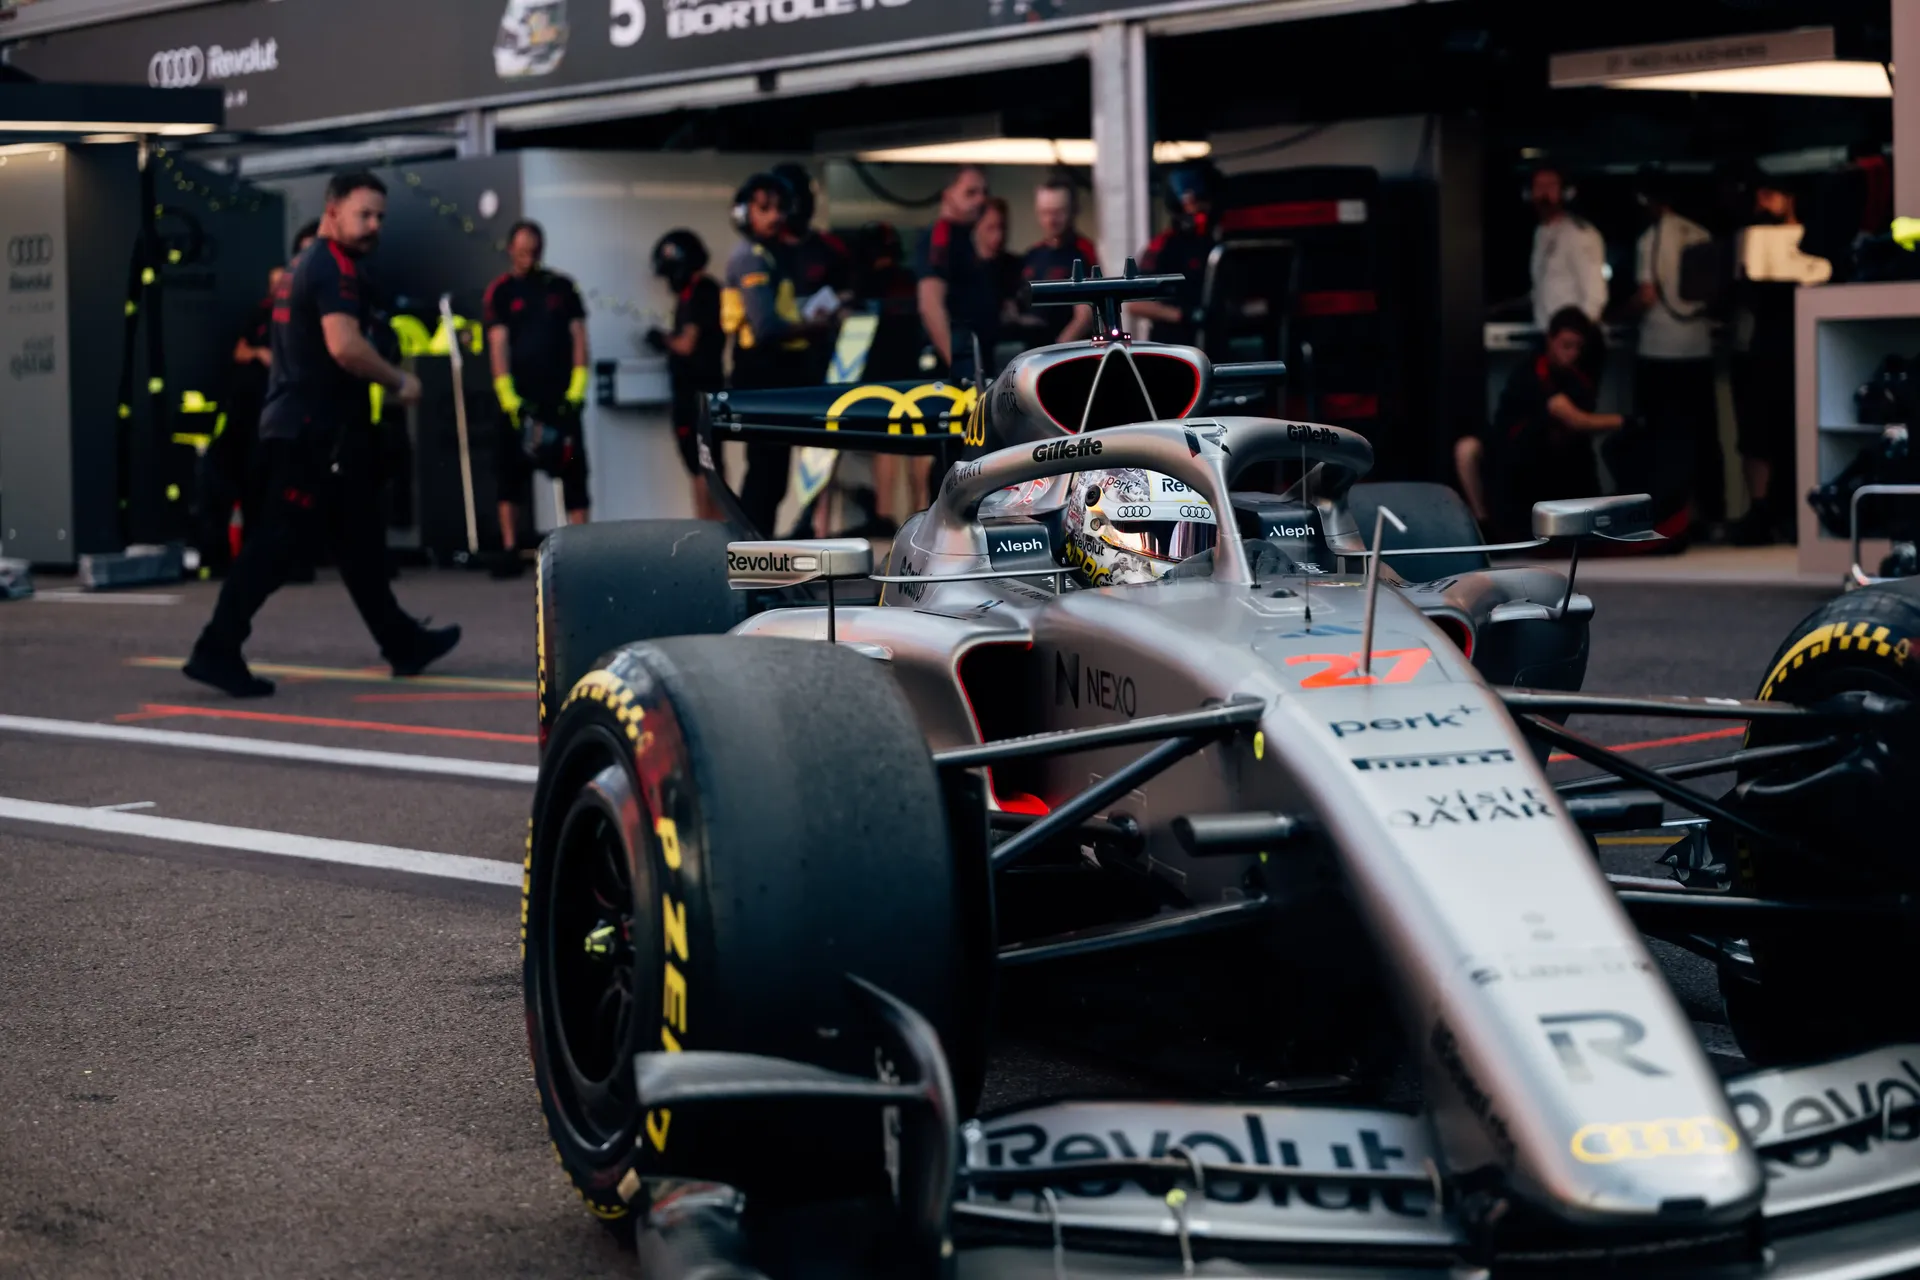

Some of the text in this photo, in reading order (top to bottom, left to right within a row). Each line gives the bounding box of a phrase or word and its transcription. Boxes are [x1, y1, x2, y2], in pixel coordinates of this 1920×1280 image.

[1287, 424, 1340, 445] Gillette
[1032, 438, 1103, 463] Gillette
[1162, 478, 1193, 493] Rev
[1269, 524, 1315, 538] Aleph
[996, 538, 1043, 553] Aleph
[727, 551, 790, 573] Revolut
[1285, 648, 1432, 689] 27
[1086, 666, 1137, 718] NEXO
[985, 1113, 1428, 1217] Revolut
